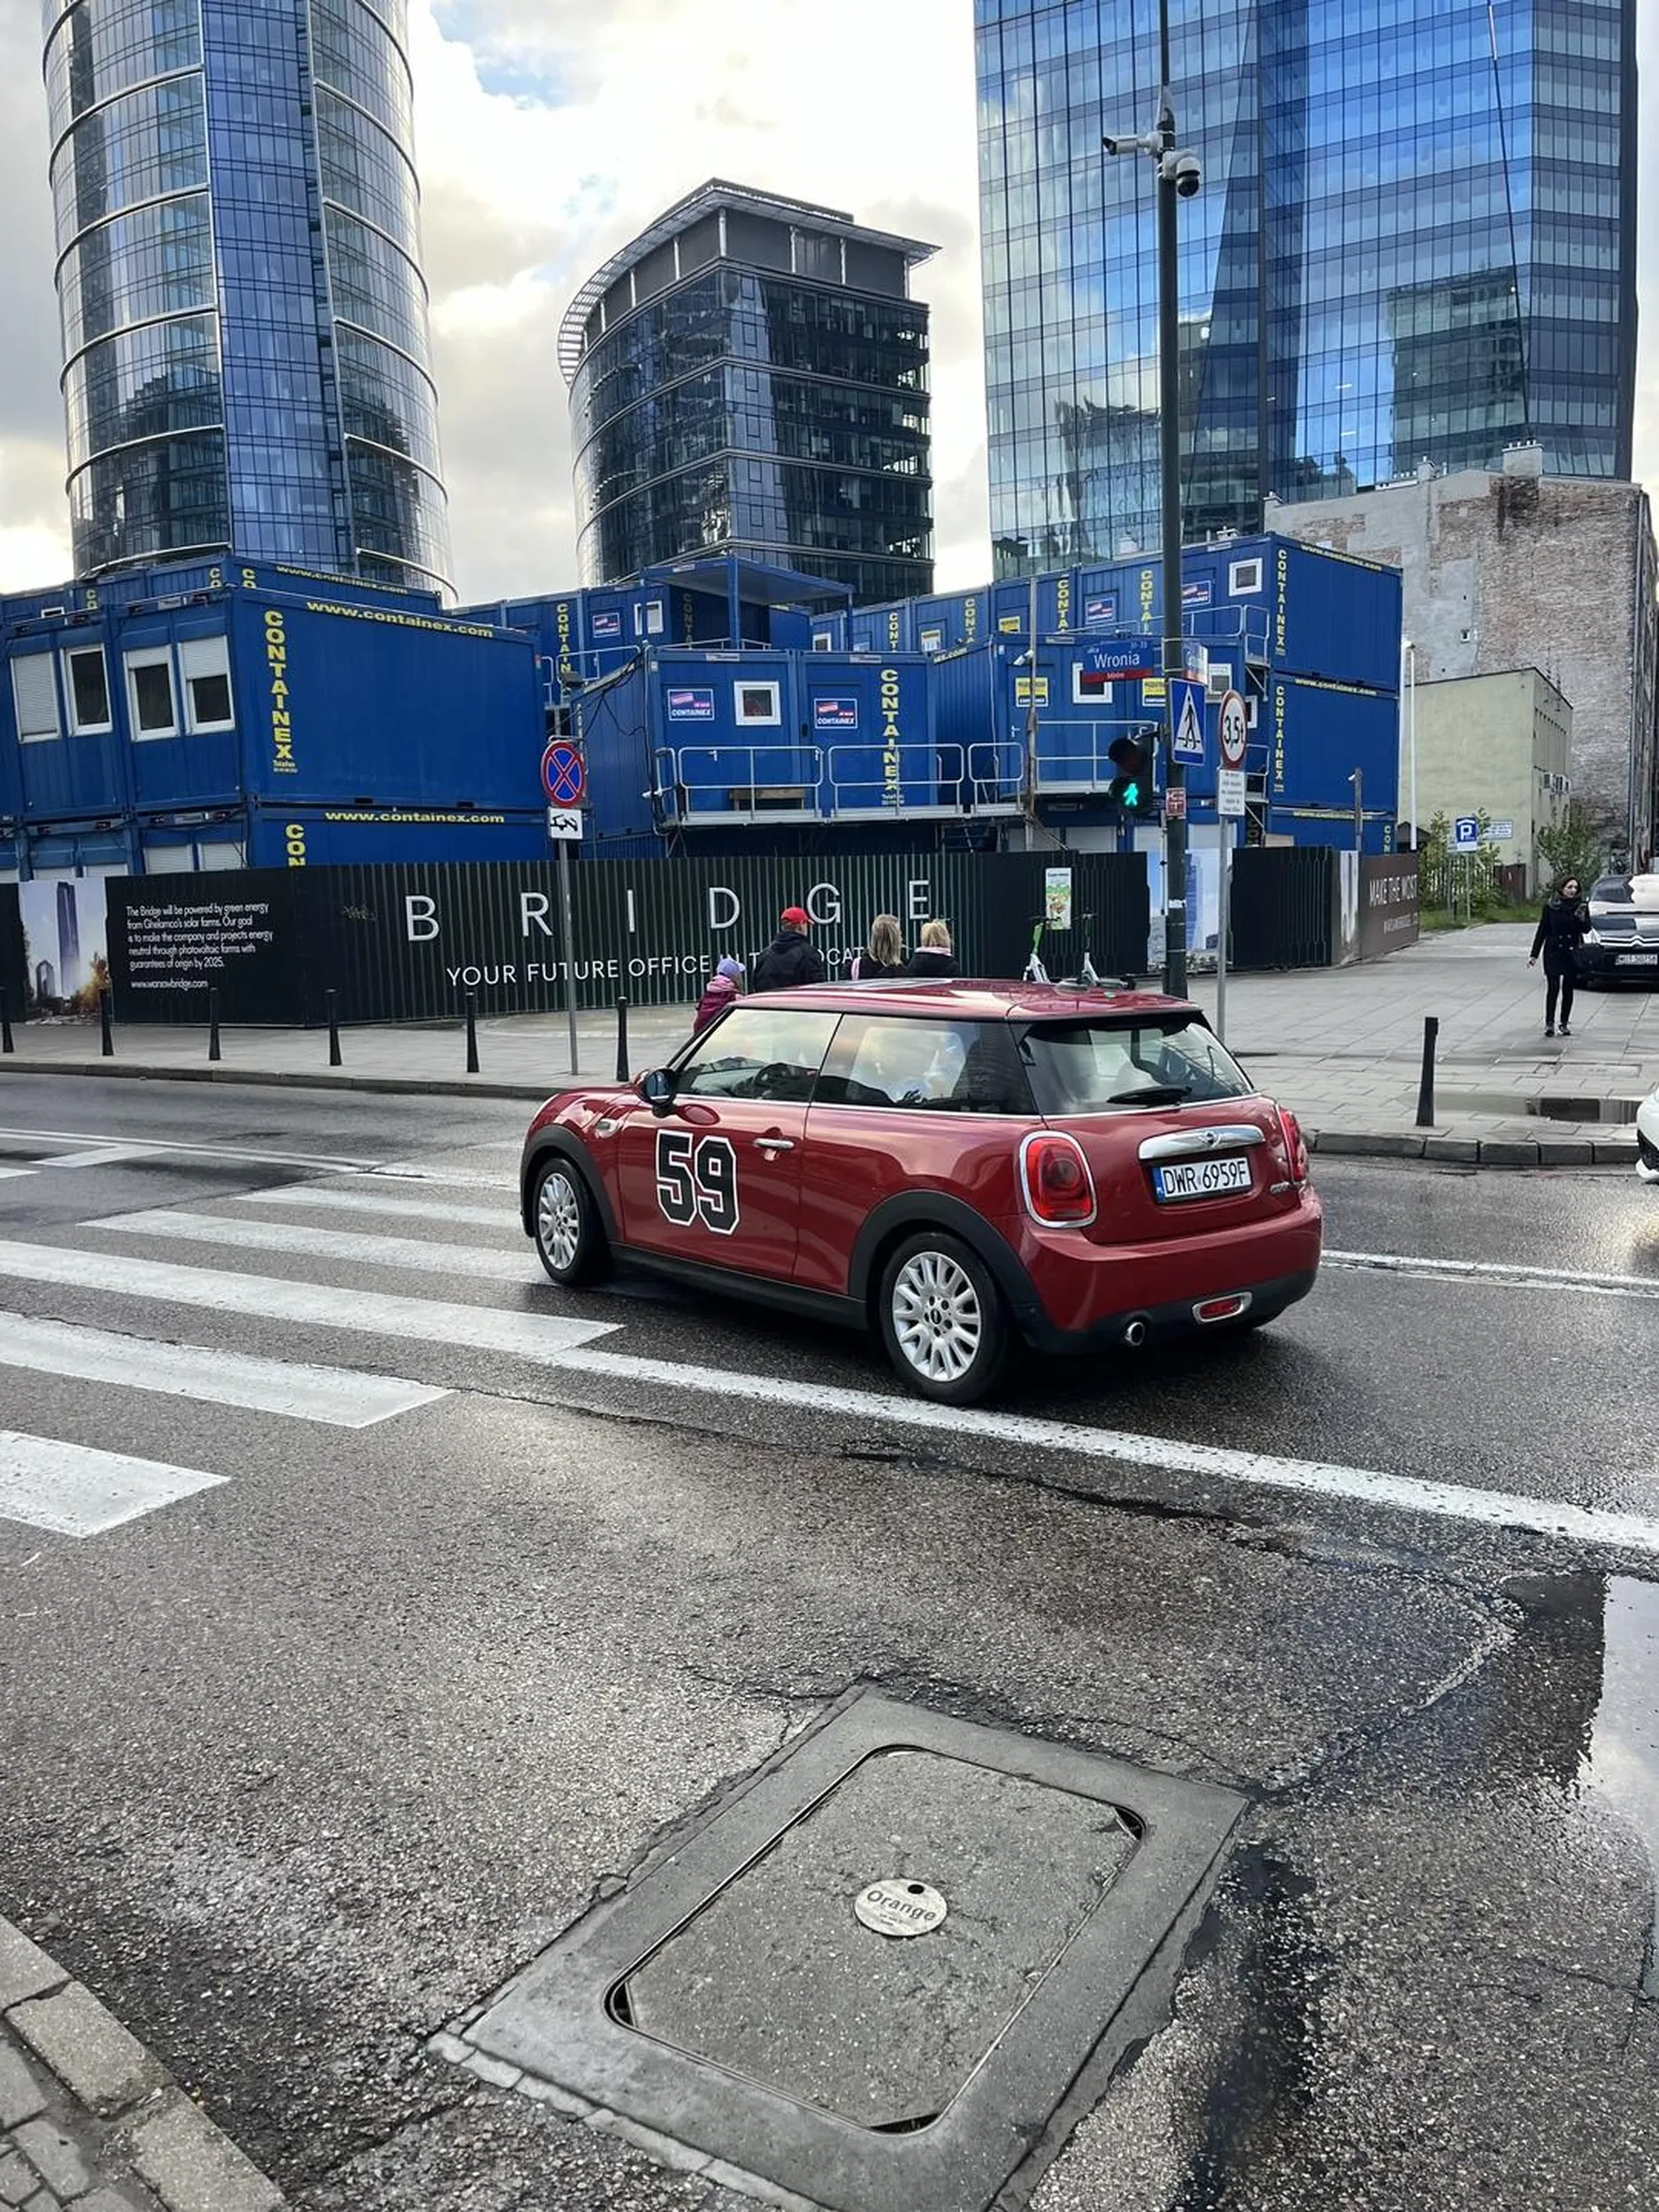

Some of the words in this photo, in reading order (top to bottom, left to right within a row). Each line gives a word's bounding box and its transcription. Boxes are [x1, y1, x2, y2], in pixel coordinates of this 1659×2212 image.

[1278, 549, 1286, 646] CONTAINEX
[307, 601, 494, 638] www.containex.com
[1094, 650, 1141, 669] Wronia
[265, 611, 294, 759] CONTAINEX
[881, 669, 899, 791] CONTAINEX
[1275, 686, 1285, 780] CONTAINEX
[325, 810, 505, 824] www.containex.com
[126, 905, 139, 917] The
[140, 905, 161, 918] Bridge
[163, 904, 173, 916] will
[174, 904, 183, 915] be
[184, 902, 213, 917] powered
[214, 902, 222, 916] by
[224, 903, 243, 917] green
[245, 902, 269, 914] energy
[127, 920, 142, 930] from
[184, 918, 199, 928] solar
[222, 915, 237, 926] Our
[238, 914, 253, 928] goal
[128, 944, 151, 956] neutral
[152, 945, 178, 958] through
[179, 943, 219, 956] photovoltaic
[220, 943, 240, 954] farms
[242, 942, 256, 954] with
[142, 932, 160, 943] make
[162, 932, 173, 942] the
[173, 933, 205, 944] company
[206, 930, 219, 941] and
[220, 930, 248, 942] projects
[249, 931, 273, 941] energy
[129, 960, 165, 972] guarantees
[166, 958, 173, 969] of
[174, 958, 194, 972] origin
[194, 957, 204, 970] by
[204, 956, 225, 968] 2025.
[447, 965, 517, 987] YOUR
[527, 959, 618, 983] FUTURE
[628, 955, 710, 977] OFFICE
[656, 1129, 741, 1235] 59
[1163, 1166, 1197, 1194] DWR
[1202, 1160, 1248, 1189] 6959F
[867, 1890, 937, 1922] Orange
